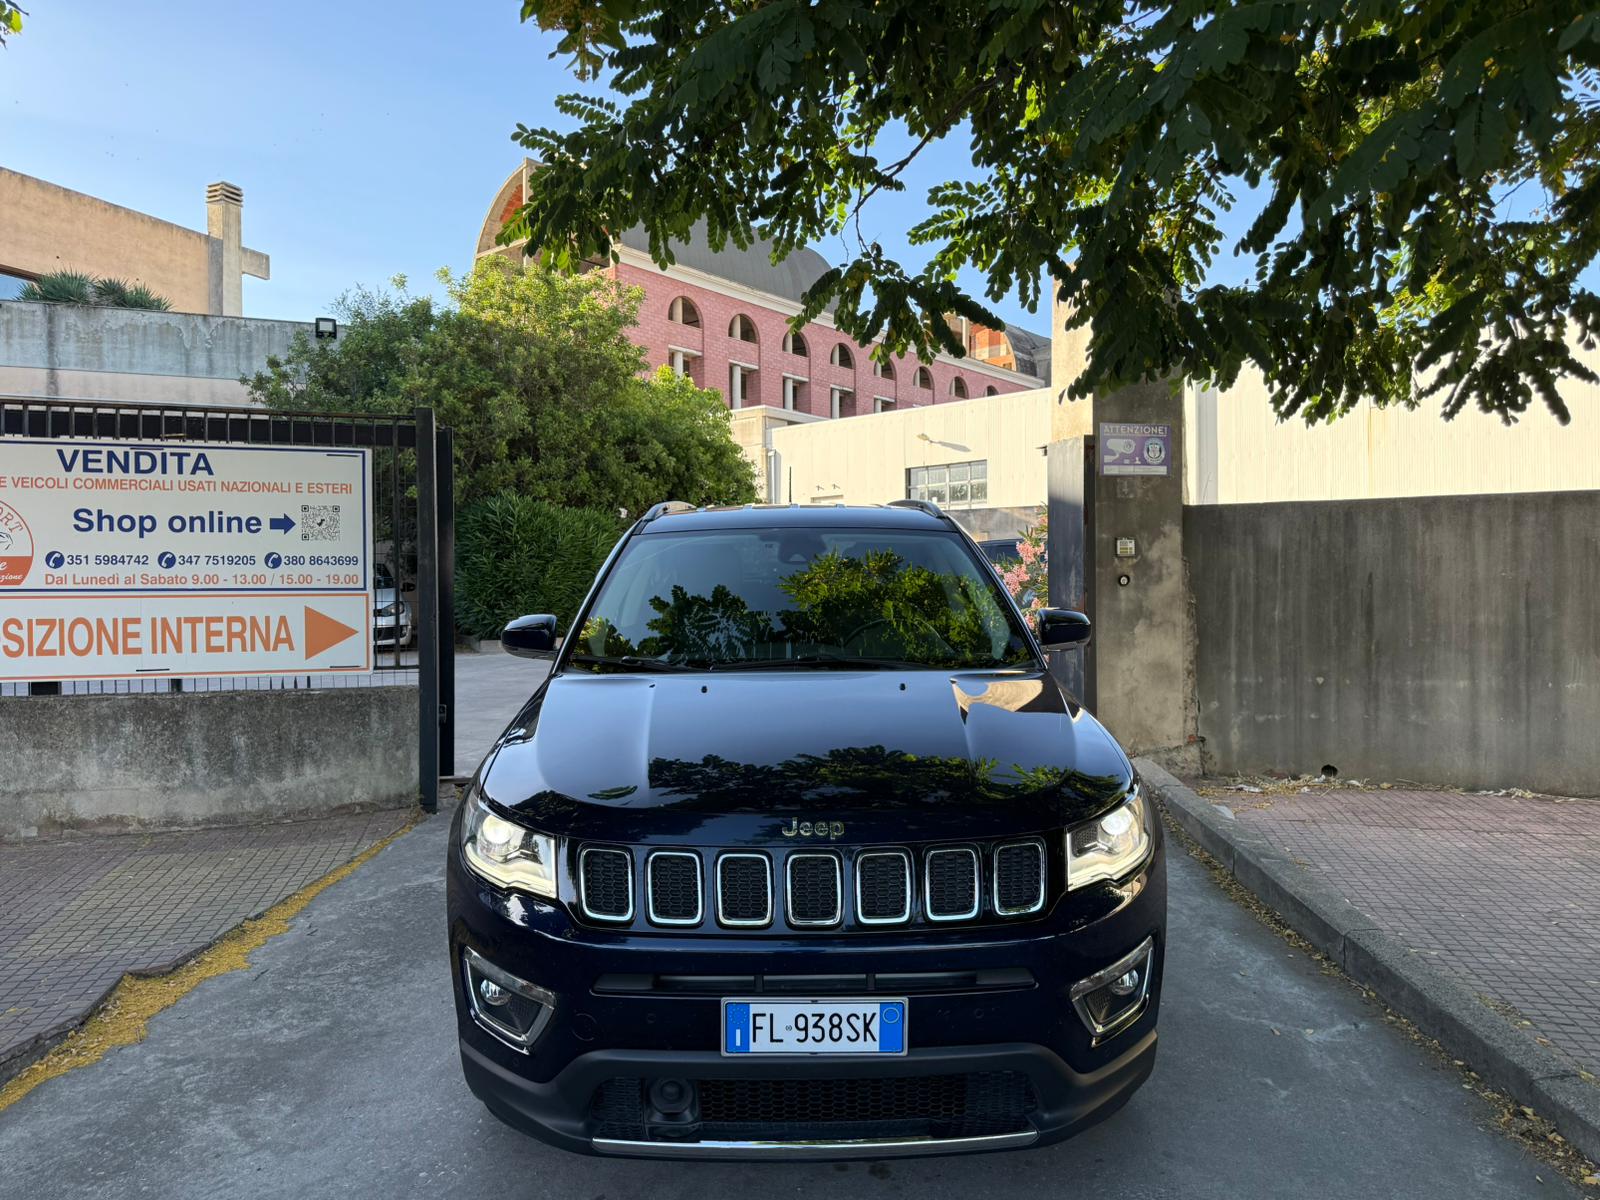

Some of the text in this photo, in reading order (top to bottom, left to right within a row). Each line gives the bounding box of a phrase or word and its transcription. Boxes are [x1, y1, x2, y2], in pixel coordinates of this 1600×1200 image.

[56, 448, 215, 476] VENDITA
[0, 476, 353, 495] E VEICOLI COMMERCIALI USATI NAZIONALI E ESTERI
[72, 507, 262, 539] Shop online
[66, 554, 149, 566] 351 5984742
[178, 555, 256, 566] 347 7519205
[283, 555, 359, 566] 380 8643699
[44, 573, 67, 585] Dal
[72, 572, 119, 585] Lunedì
[124, 573, 136, 585] al
[140, 573, 188, 585] Sabato
[191, 574, 219, 585] 9.00
[232, 574, 267, 585] 13.00
[279, 574, 313, 585] 15.00
[325, 574, 359, 585] 19.00
[2, 615, 296, 658] SIZIONE INTERNA
[781, 816, 845, 840] Jeep
[752, 1013, 784, 1043] FL
[794, 1013, 877, 1043] 938SK
